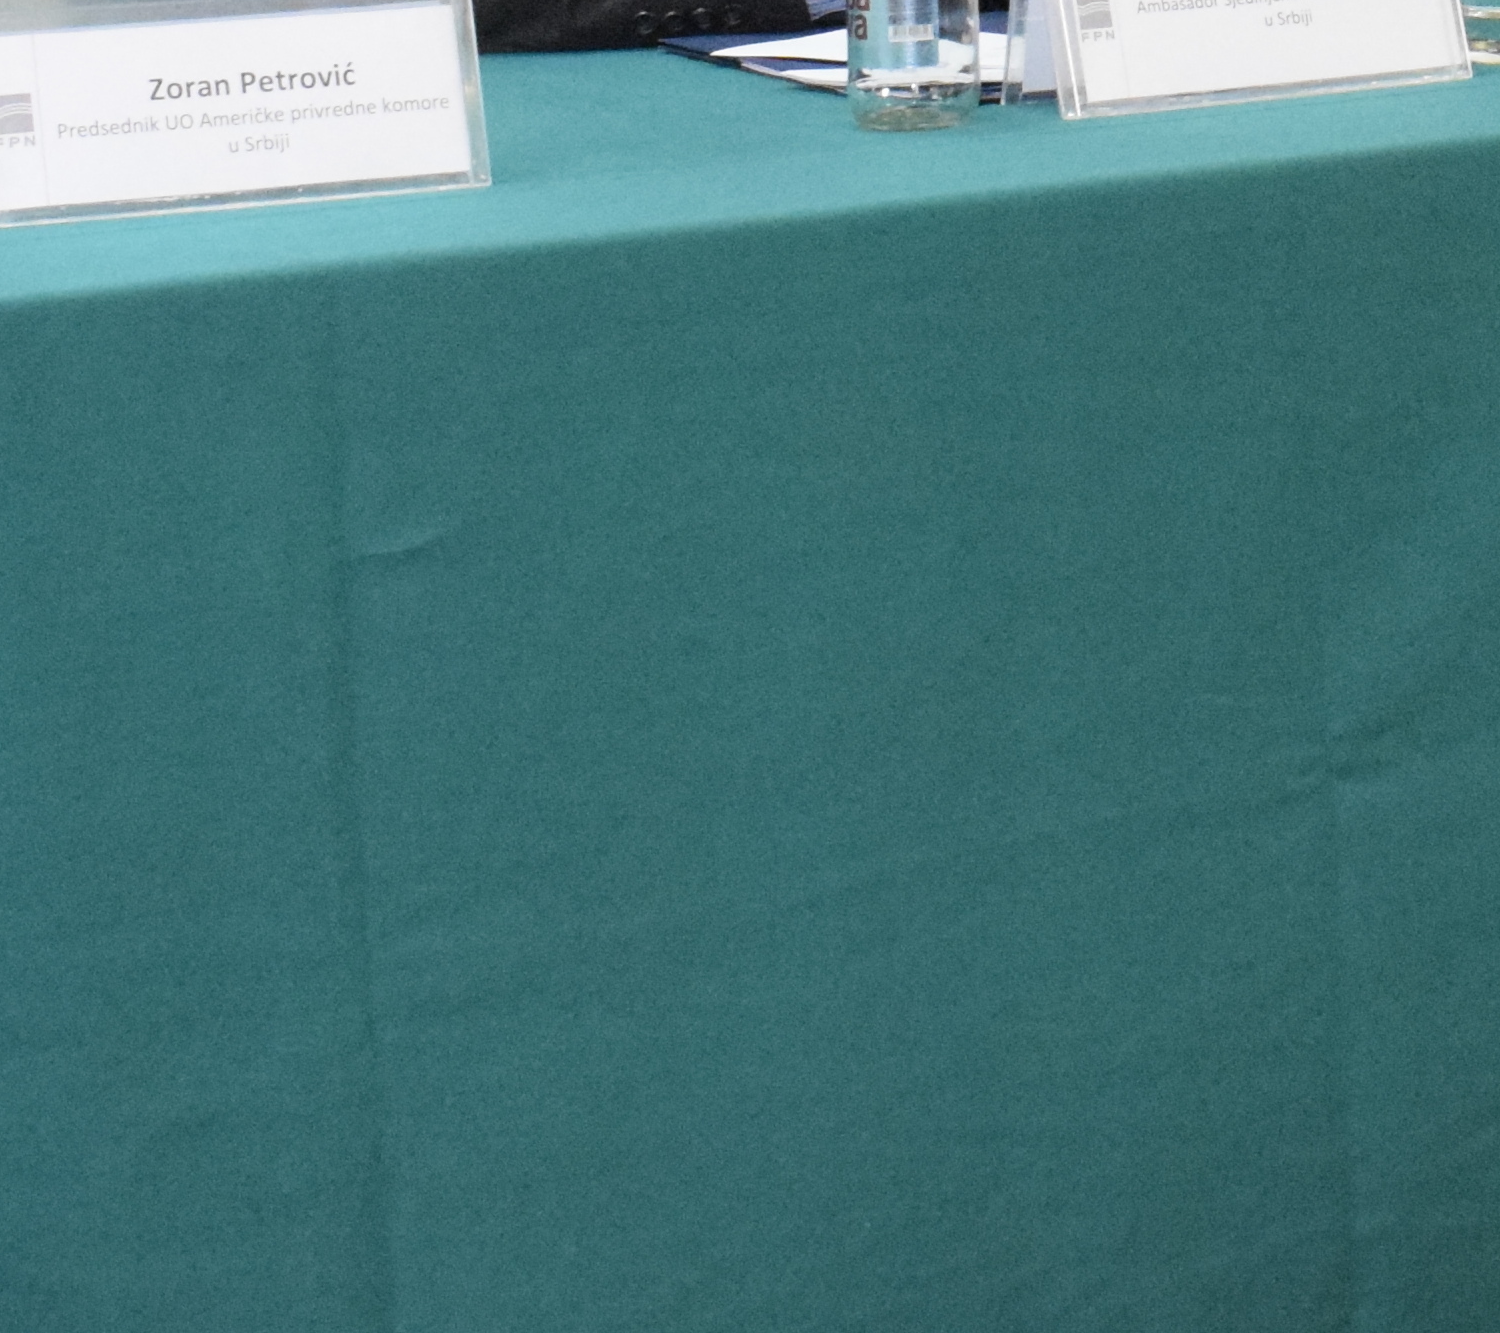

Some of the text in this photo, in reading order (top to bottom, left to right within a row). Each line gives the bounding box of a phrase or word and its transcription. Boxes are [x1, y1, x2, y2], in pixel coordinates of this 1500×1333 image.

[1264, 9, 1313, 28] u Srbiji
[1081, 30, 1116, 42] FPN
[149, 62, 356, 101] Zoran Petrović
[57, 93, 450, 139] Predsednik UO Američke privredne komore
[228, 134, 290, 154] u Srbiji
